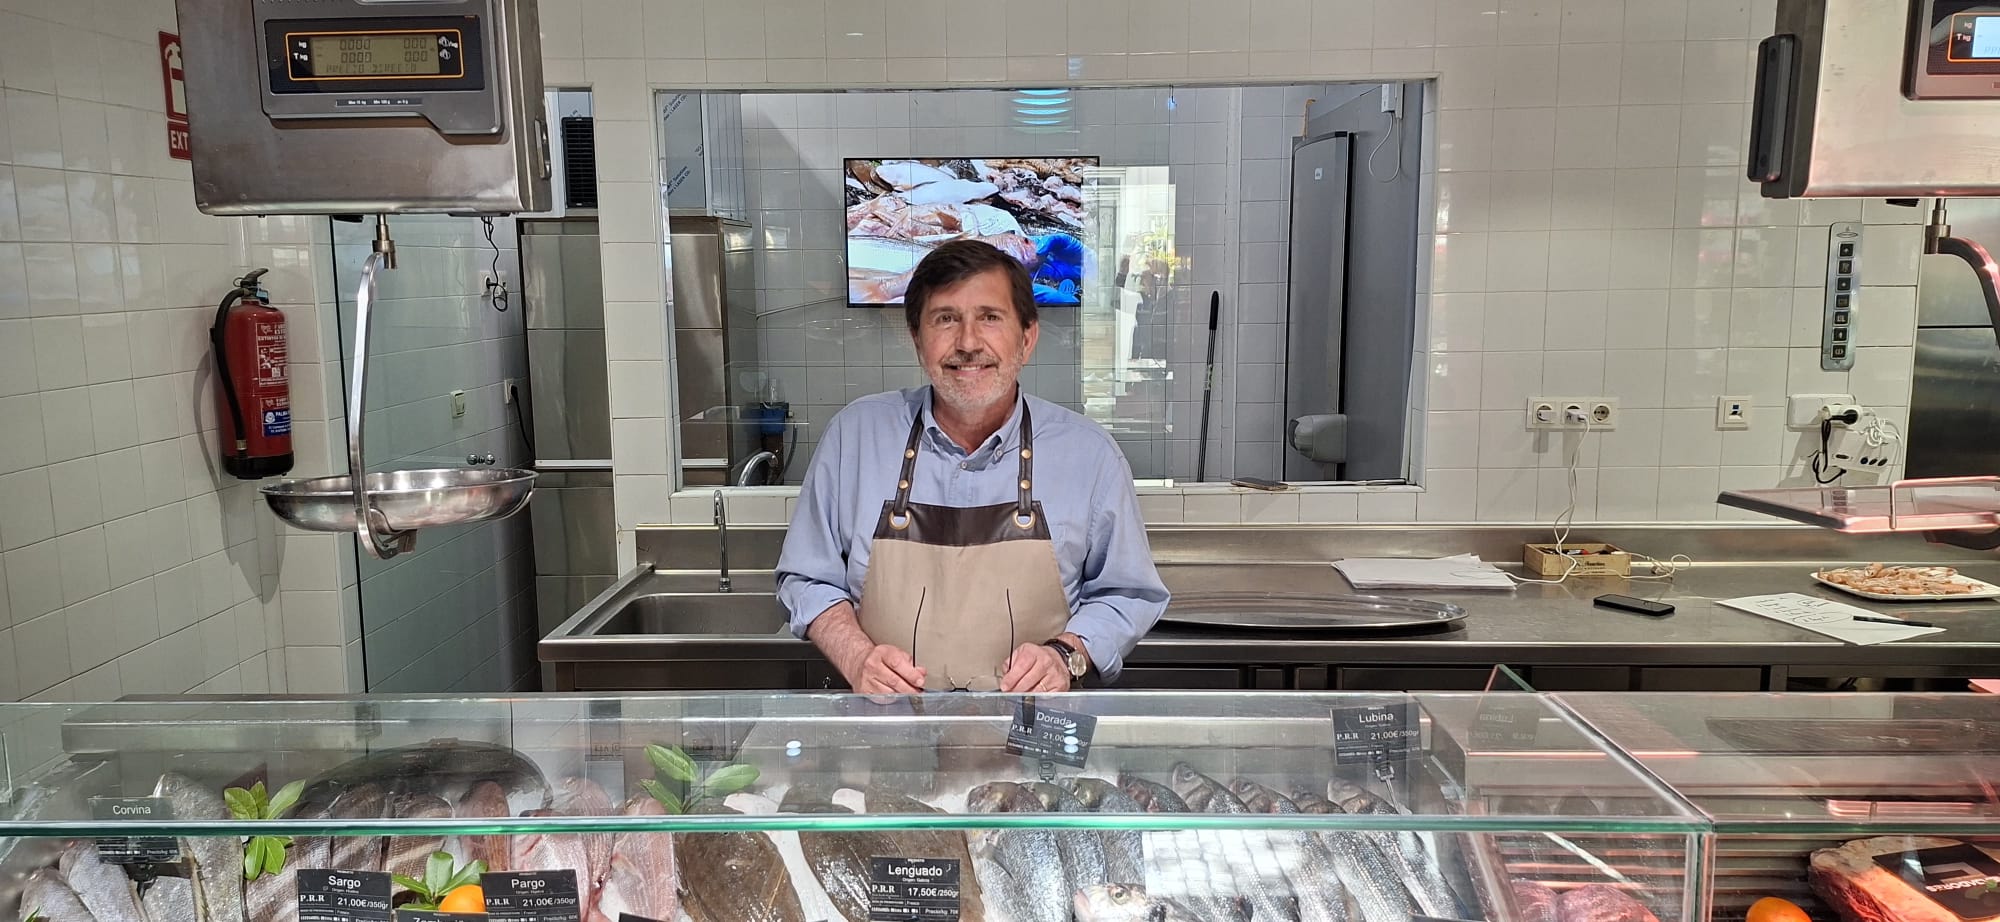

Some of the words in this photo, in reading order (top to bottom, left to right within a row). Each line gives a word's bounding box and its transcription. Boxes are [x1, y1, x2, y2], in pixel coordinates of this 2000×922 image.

[1036, 711, 1073, 726] Dorada
[1358, 712, 1394, 723] Lubina
[112, 805, 151, 815] Corvina
[888, 864, 943, 878] Lenguado
[328, 875, 361, 889] Sargo
[511, 878, 546, 890] Pargo
[871, 884, 896, 893] P.R.R
[300, 894, 325, 902] P.R.R
[485, 898, 510, 906] P.R.R
